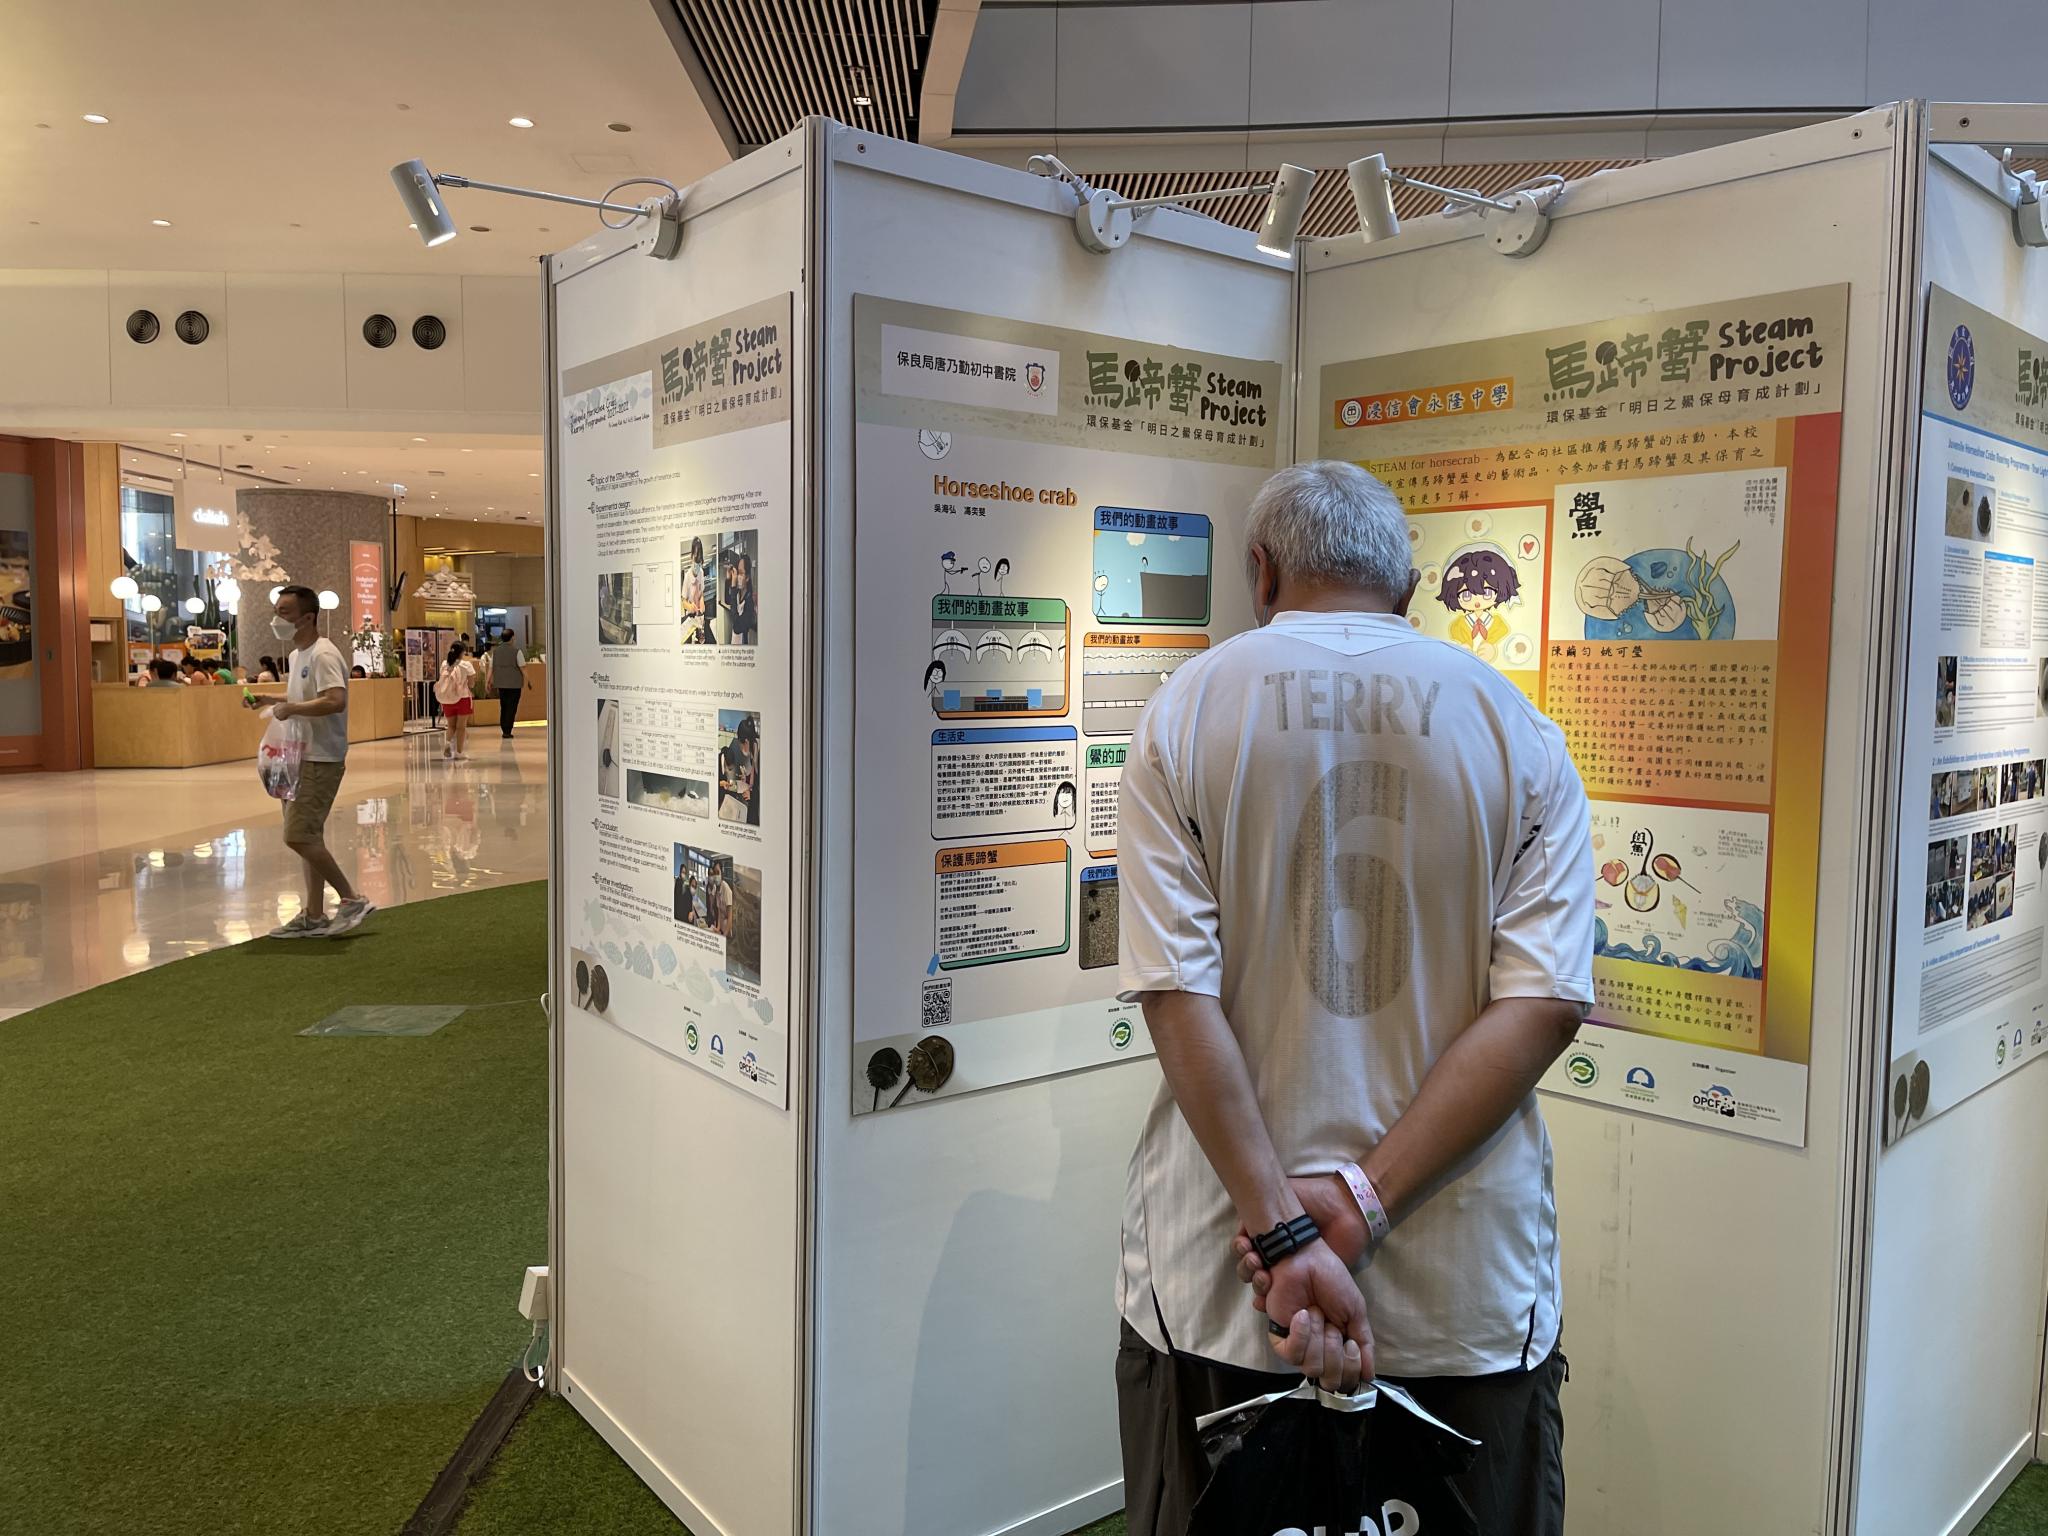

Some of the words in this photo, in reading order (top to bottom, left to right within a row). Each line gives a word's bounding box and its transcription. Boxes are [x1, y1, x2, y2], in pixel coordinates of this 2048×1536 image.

[736, 324, 777, 355] Steam
[1718, 314, 1814, 348] Steam
[661, 328, 732, 406] 馬蹄蟹
[732, 348, 782, 386] Project
[896, 350, 1017, 383] 保良局唐乃勤初中書院
[1544, 320, 1710, 402] 馬蹄蟹
[1710, 341, 1824, 382] Project
[1085, 350, 1202, 416] 馬蹄蟹
[1206, 371, 1262, 398] Steam
[1200, 396, 1267, 427] Project
[1366, 382, 1509, 420] 浸信會永隆中學
[1370, 461, 1407, 473] STEAM
[1411, 459, 1426, 470] for
[1429, 455, 1480, 468] horsecrab
[933, 474, 1035, 504] Horseshoe
[1038, 486, 1077, 507] crab
[1100, 510, 1178, 530] 我們的動畫故事
[937, 599, 1029, 617] 我們的動畫故事
[1263, 669, 1440, 737] TERRY
[937, 731, 965, 742] 生活史
[940, 850, 998, 868] 保護馬蹄蟹
[1289, 760, 1415, 1019] 6
[1693, 1095, 1721, 1109] OPCF
